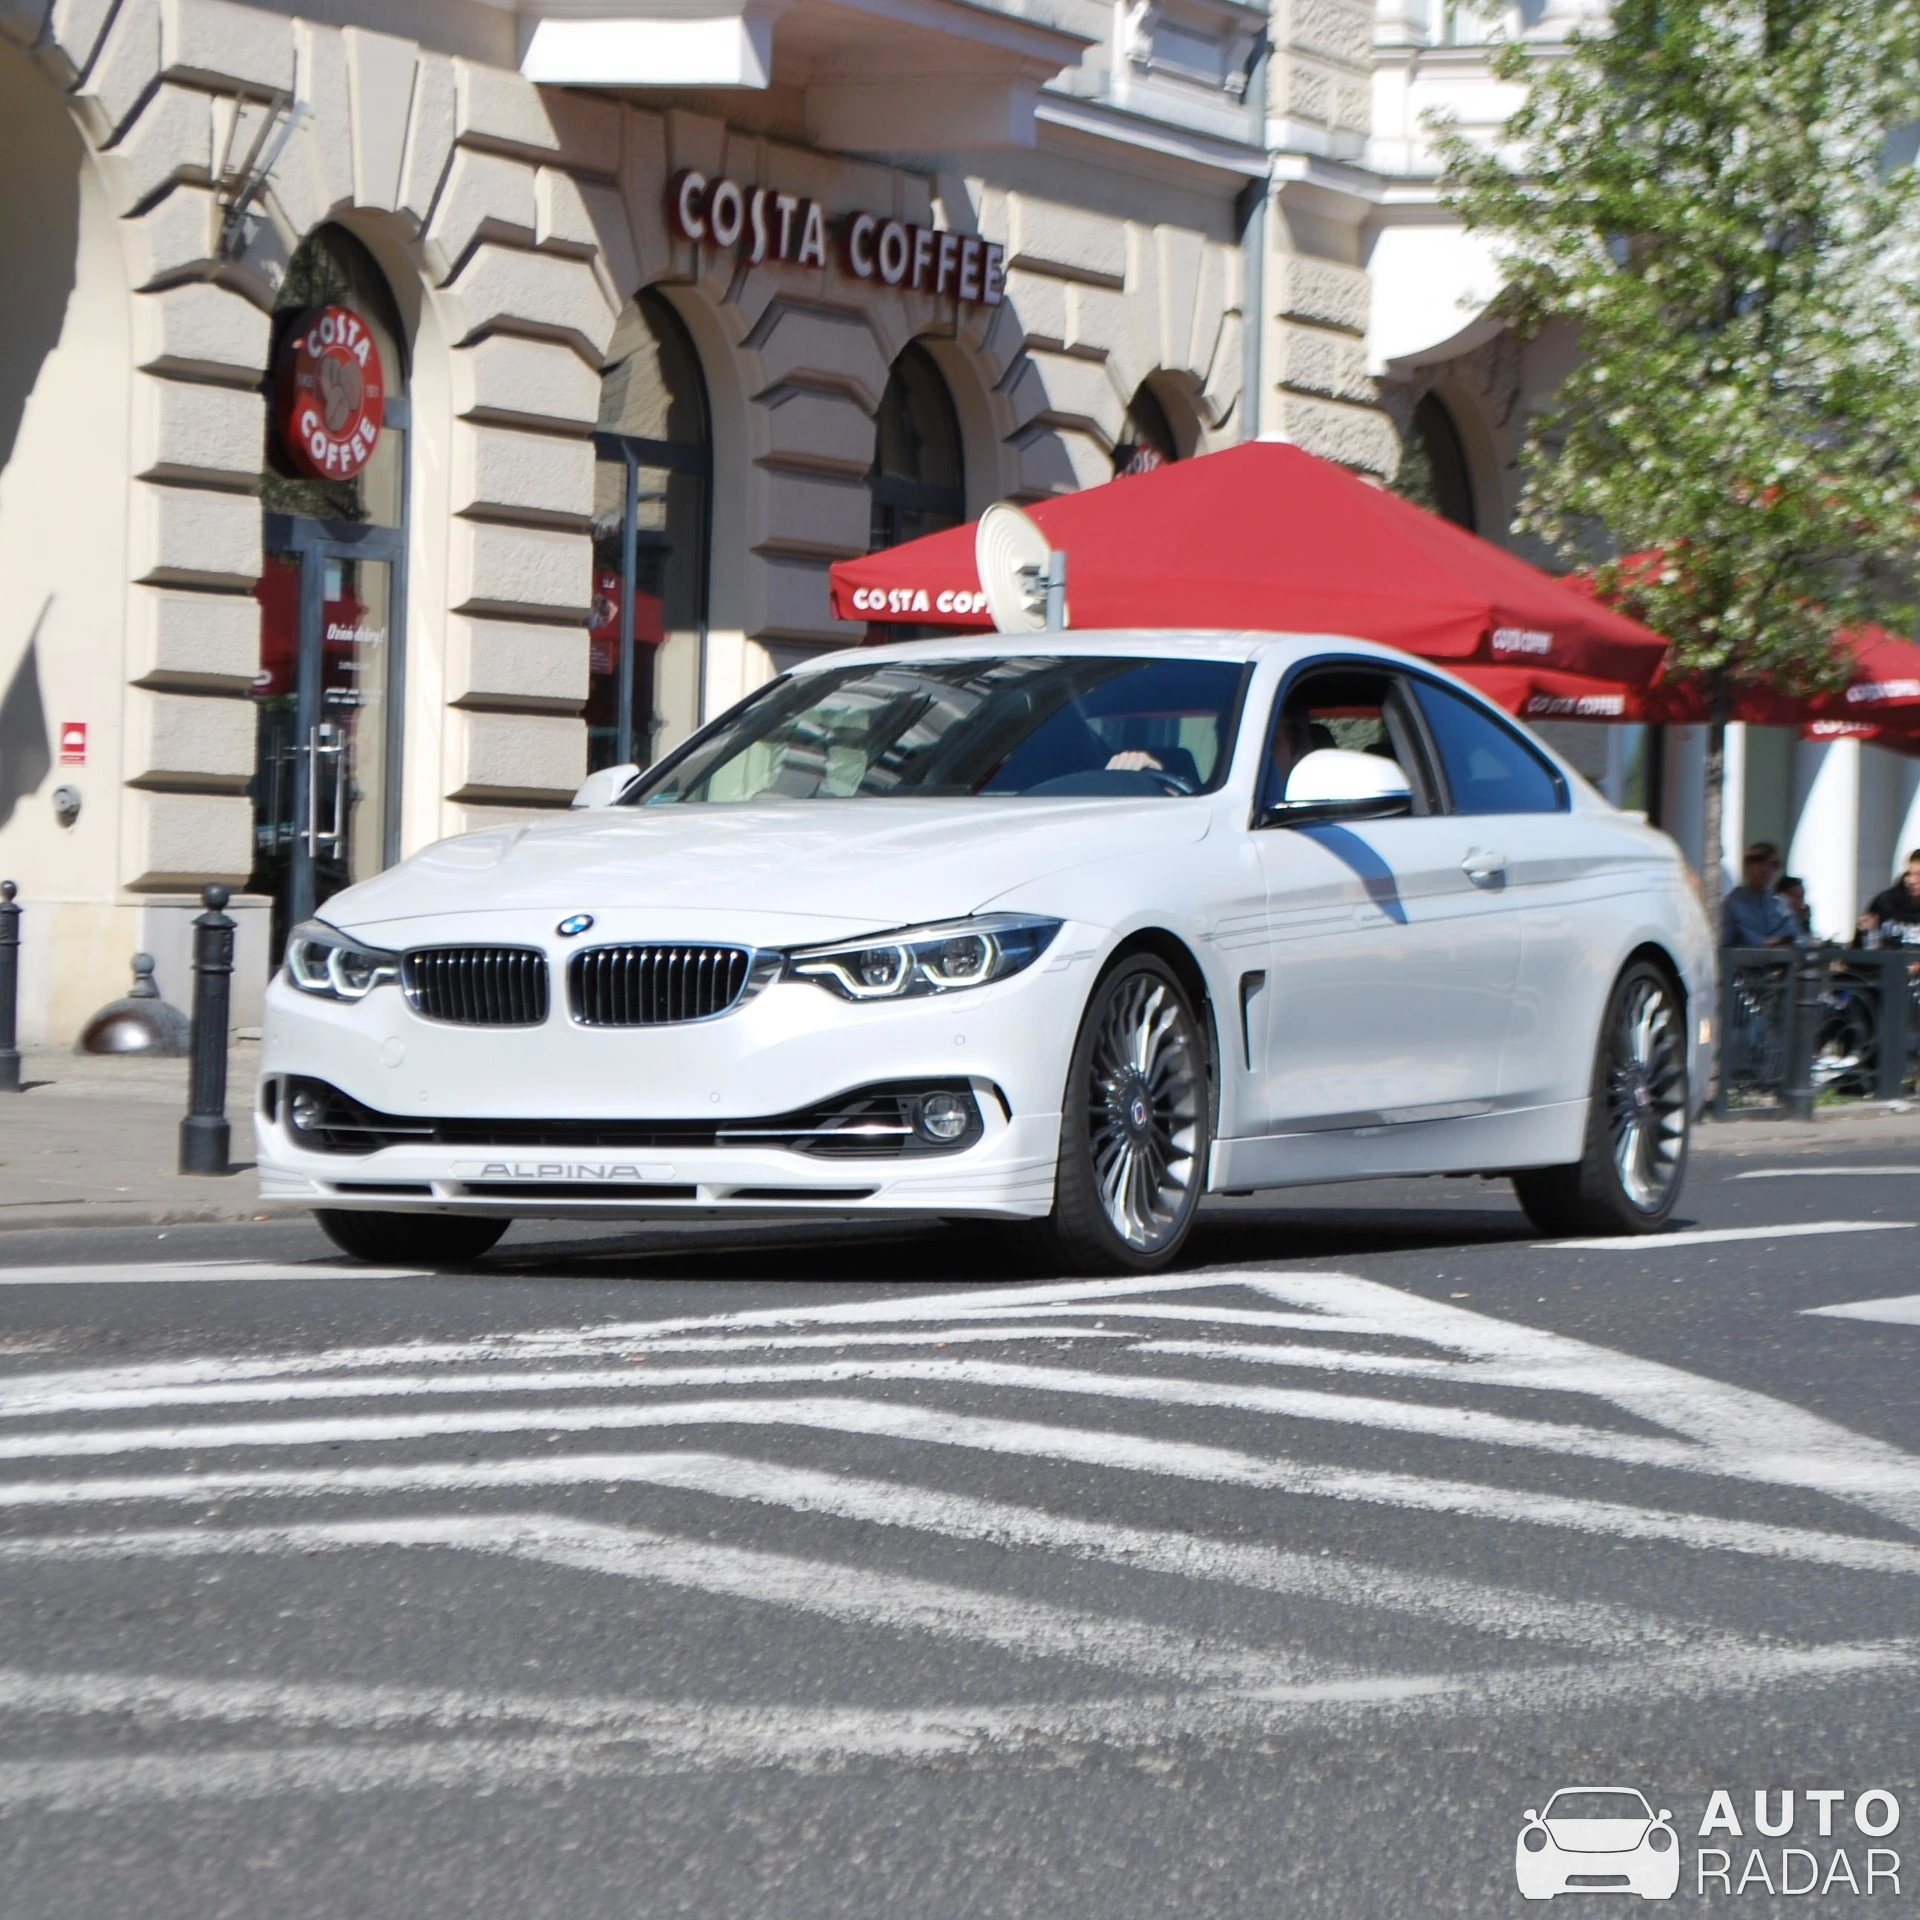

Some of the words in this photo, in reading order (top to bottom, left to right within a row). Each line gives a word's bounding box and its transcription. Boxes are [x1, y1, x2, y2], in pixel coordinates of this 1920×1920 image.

[678, 170, 826, 267] COSTA
[849, 213, 1004, 304] COFFEE
[307, 314, 371, 367] COSTA
[301, 409, 376, 473] COFFEE
[852, 588, 930, 613] COSTA
[936, 591, 991, 614] COF
[479, 1163, 643, 1180] ALPINA
